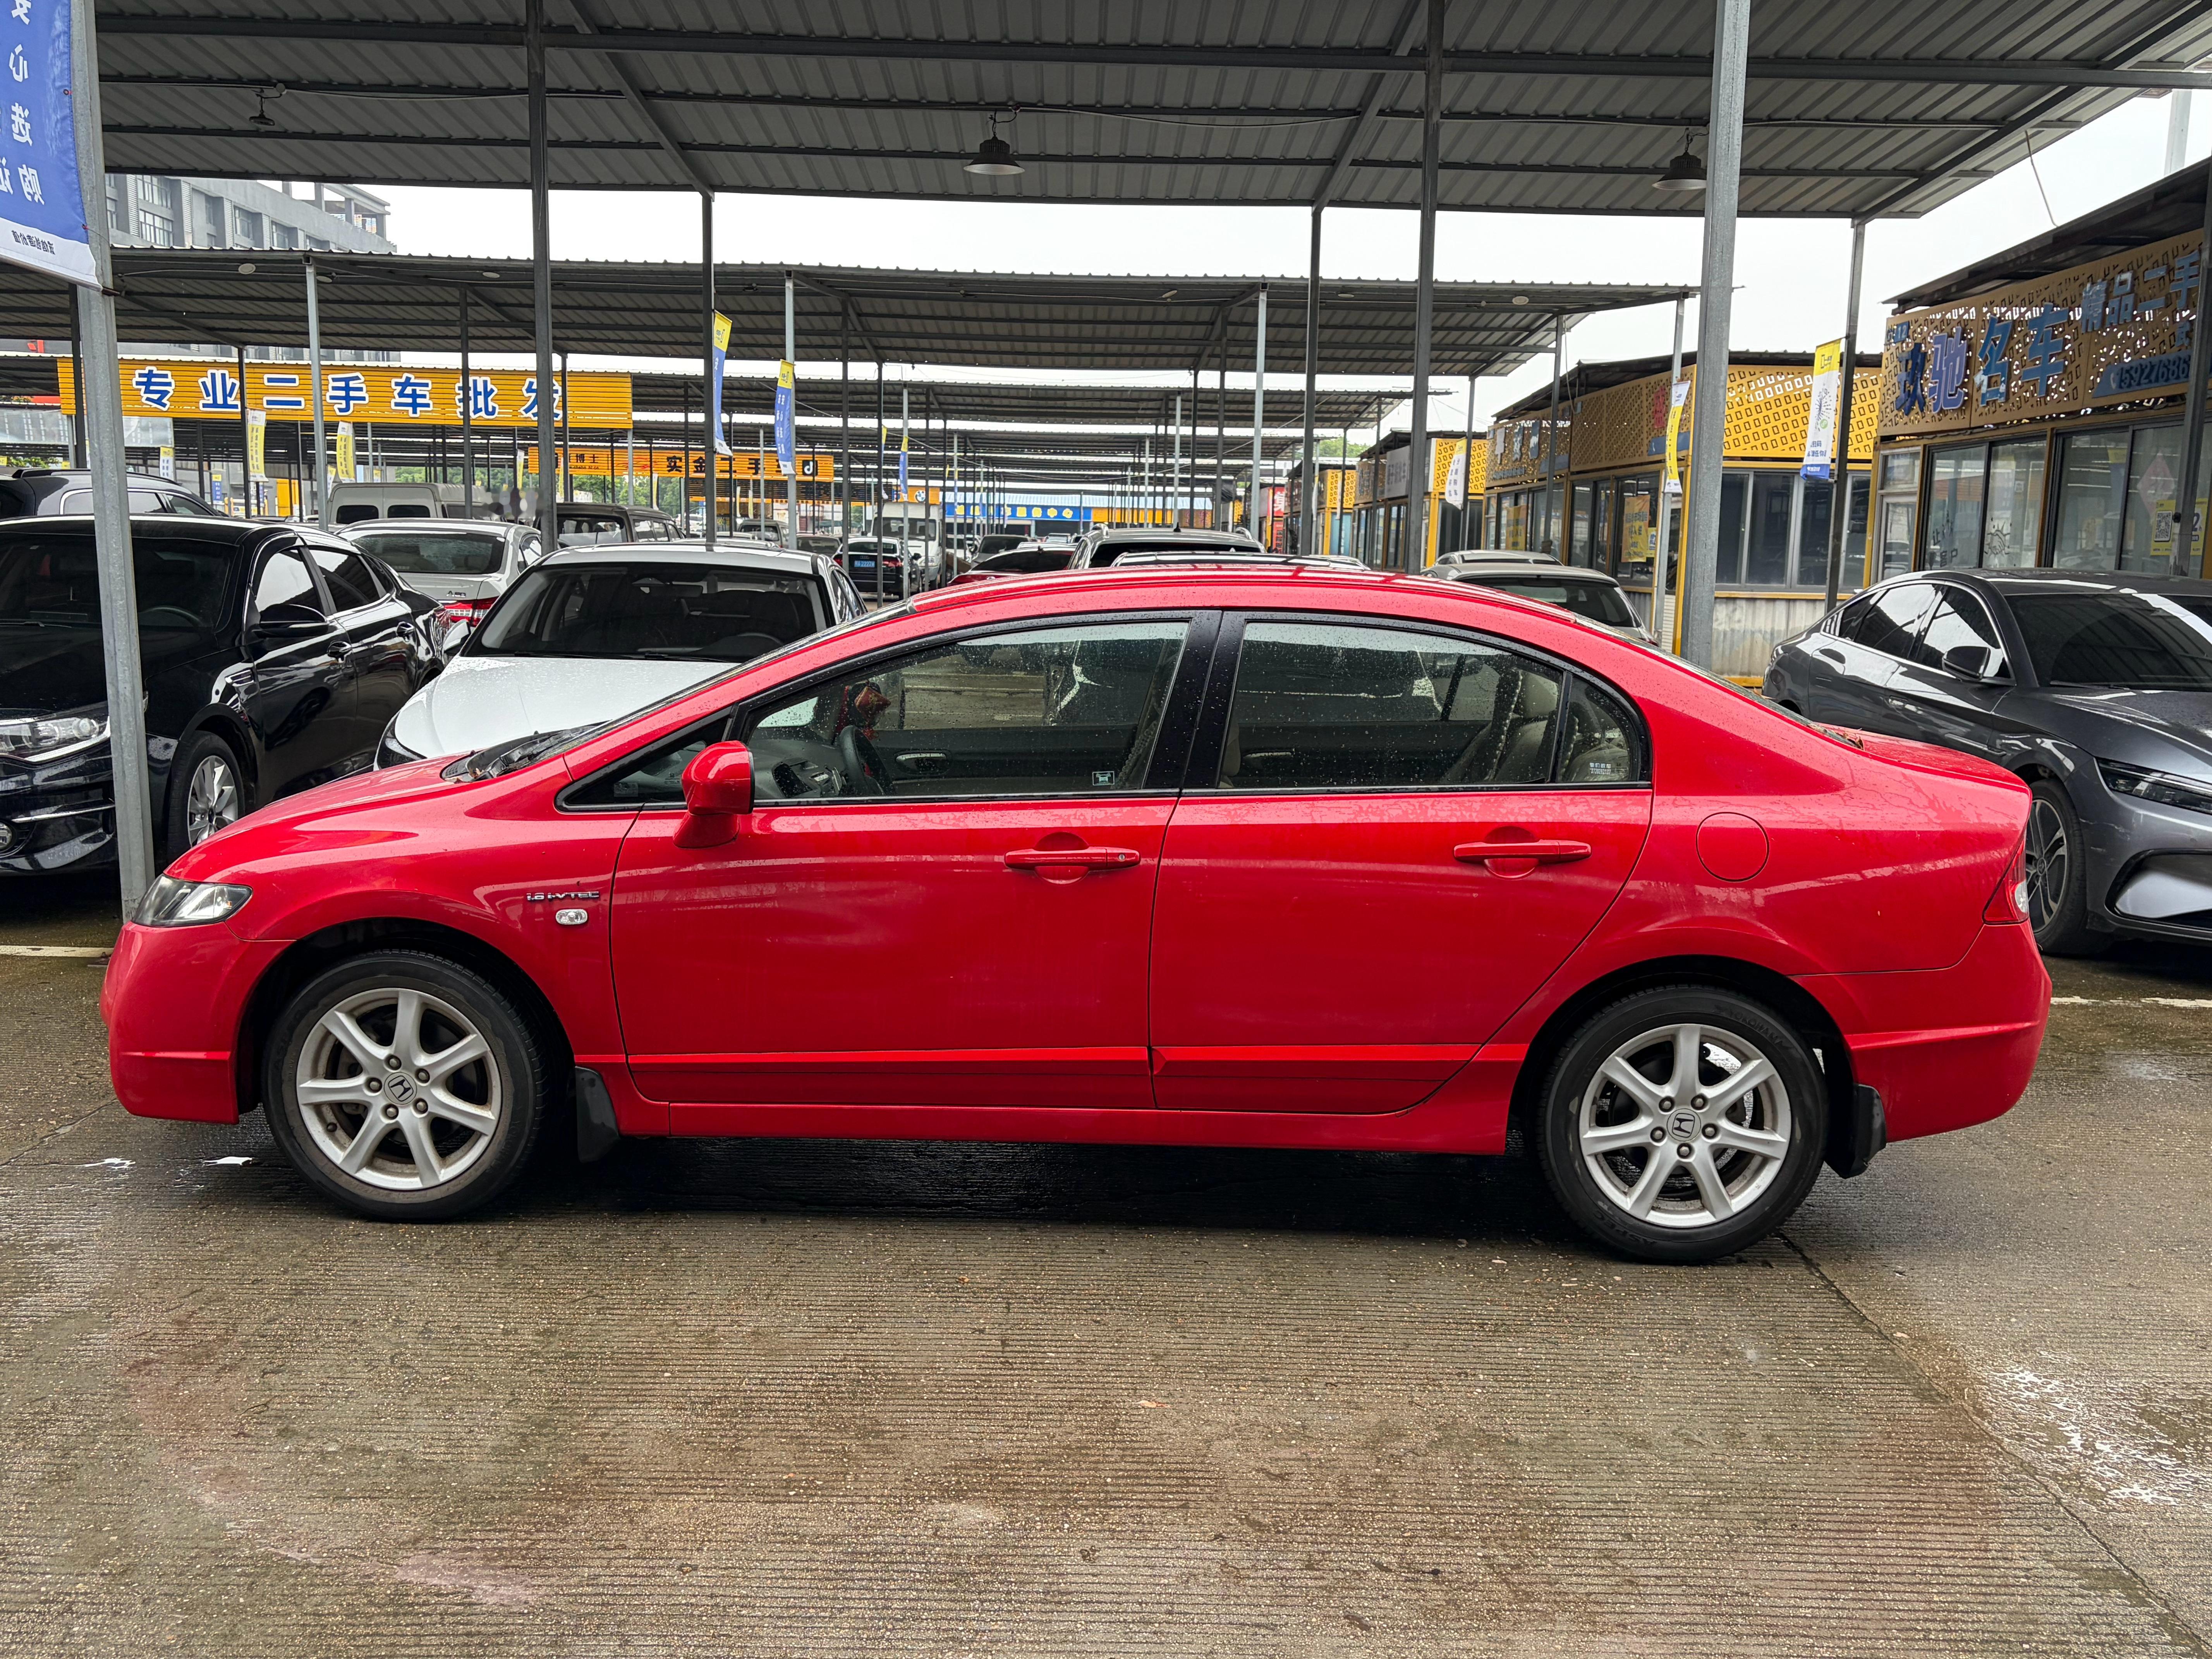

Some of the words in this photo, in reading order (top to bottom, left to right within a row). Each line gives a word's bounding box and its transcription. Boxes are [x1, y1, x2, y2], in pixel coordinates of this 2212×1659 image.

[2117, 355, 2191, 388] 15927686
[132, 366, 562, 420] 专业二手车批发
[569, 453, 599, 463] 博士
[667, 456, 782, 475] 实金二手
